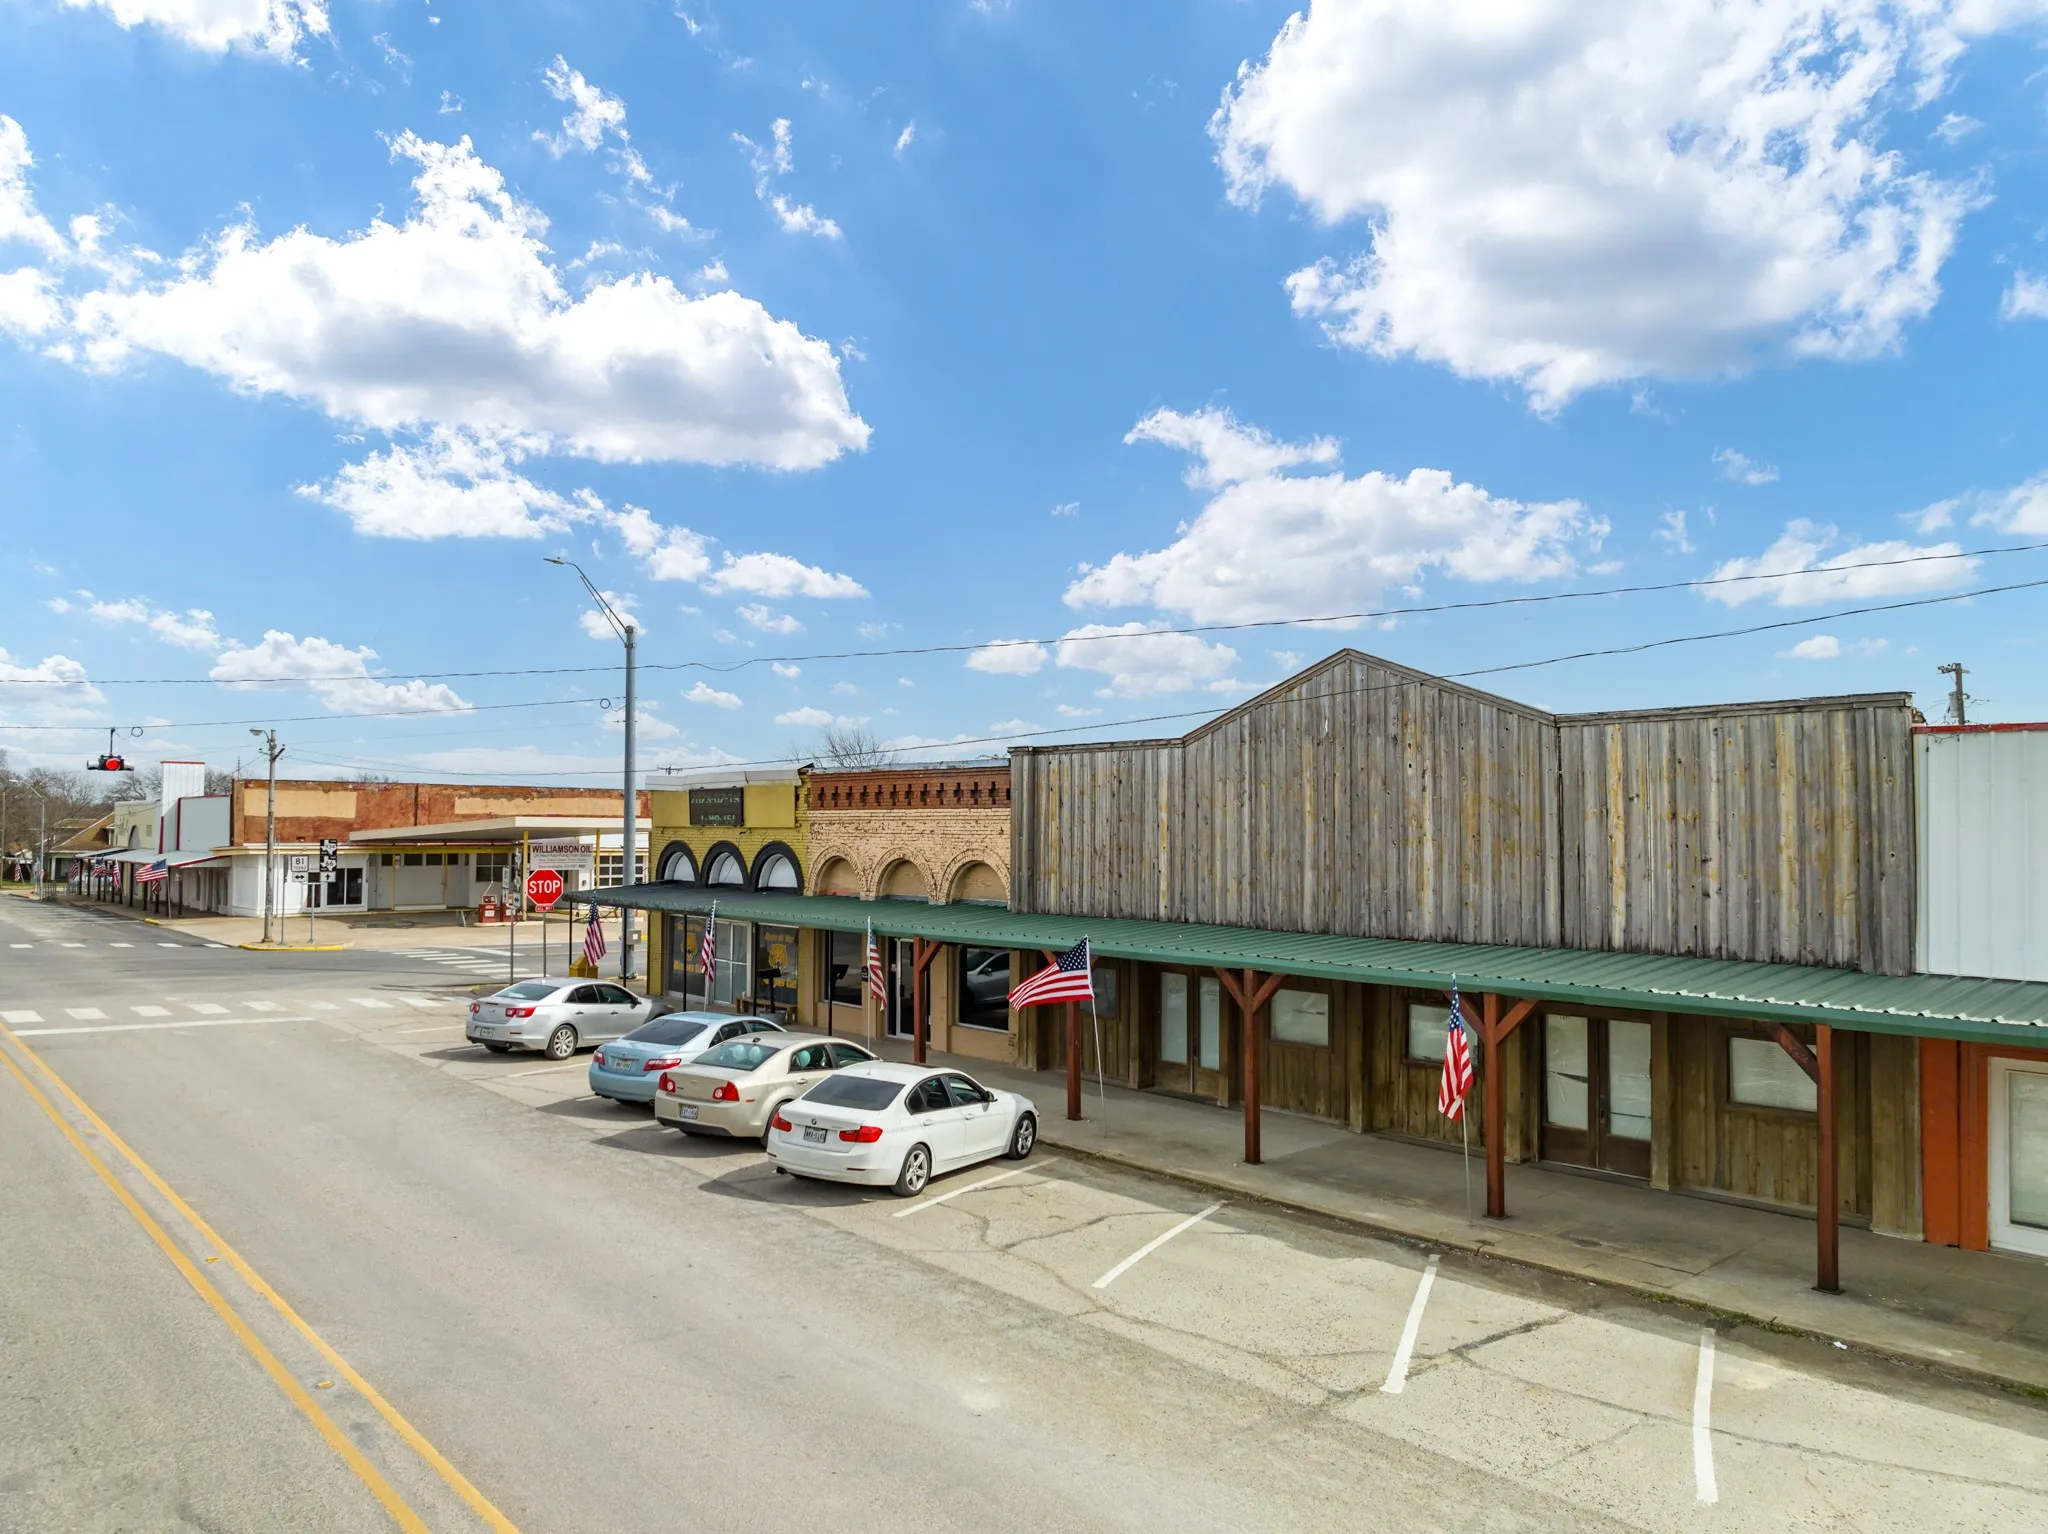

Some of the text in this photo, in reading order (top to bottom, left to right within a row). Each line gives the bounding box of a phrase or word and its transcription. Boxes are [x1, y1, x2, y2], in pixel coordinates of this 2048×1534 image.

[532, 845, 592, 853] WILLIAMSON OIL
[529, 880, 560, 894] STOP
